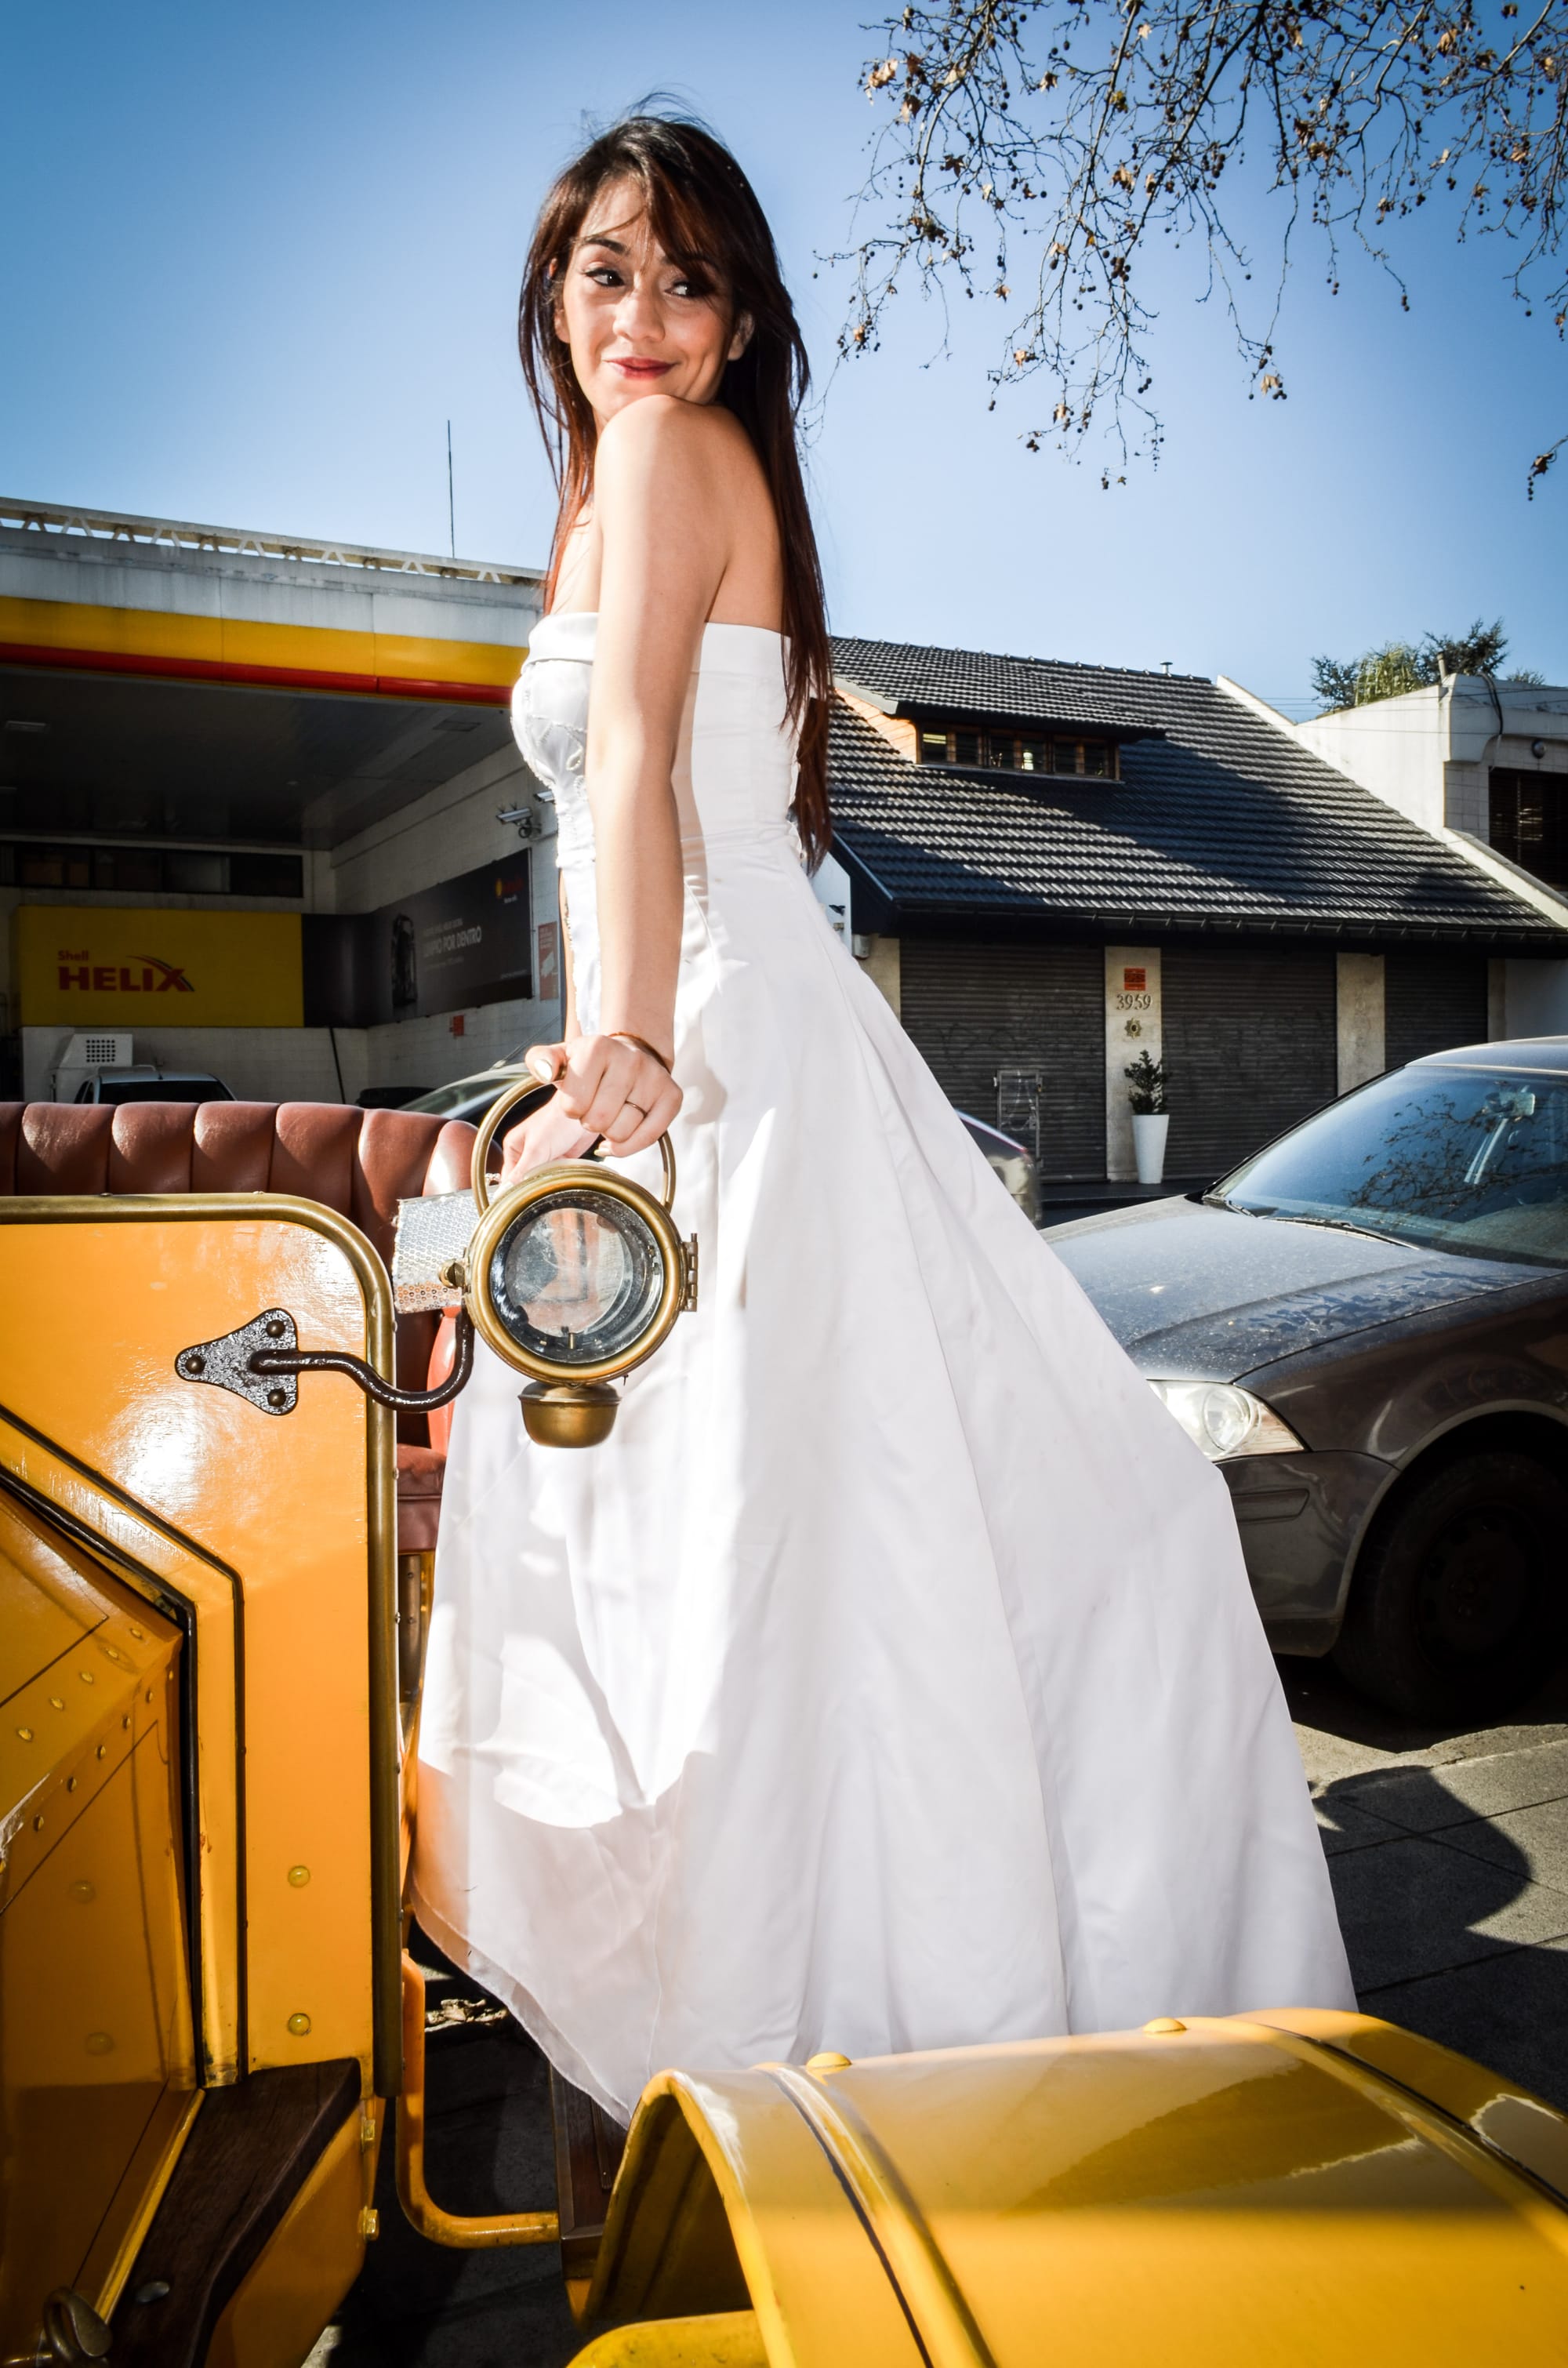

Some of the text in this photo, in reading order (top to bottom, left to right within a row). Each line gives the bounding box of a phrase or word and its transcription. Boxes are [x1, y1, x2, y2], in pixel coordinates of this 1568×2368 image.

[444, 933, 456, 952] POR
[457, 925, 482, 948] DENTRO
[58, 950, 89, 961] Shell
[58, 966, 194, 992] HELIX
[1116, 993, 1152, 1011] 3959
